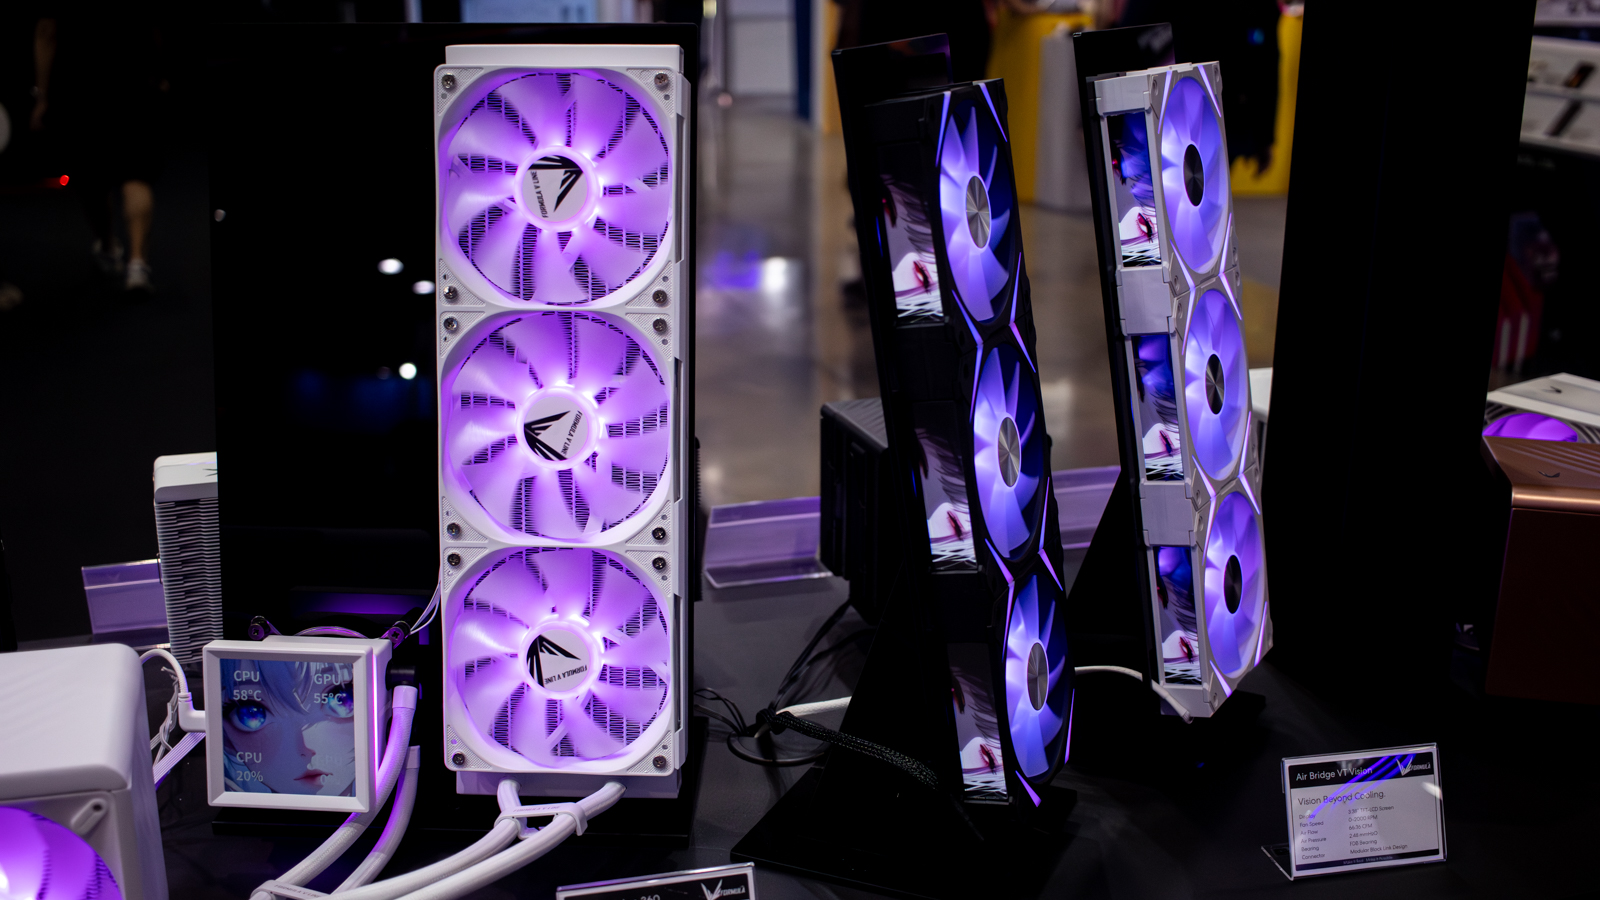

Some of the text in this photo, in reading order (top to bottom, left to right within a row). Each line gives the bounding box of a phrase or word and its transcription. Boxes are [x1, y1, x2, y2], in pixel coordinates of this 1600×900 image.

[531, 170, 539, 184] LINE
[535, 190, 548, 218] FORMULA
[568, 410, 583, 437] FORMULA
[561, 442, 570, 455] LINE
[233, 670, 260, 682] CPU
[562, 665, 588, 678] FORMULA
[313, 673, 341, 685] GPU
[544, 675, 556, 684] LINE
[233, 689, 262, 701] 58°C
[236, 751, 262, 763] CPU
[316, 754, 343, 766] PU
[236, 770, 264, 782] 20%
[1296, 766, 1373, 781] Air Bridge VT Vision
[1298, 791, 1386, 805] Vision Beyond Cooling.
